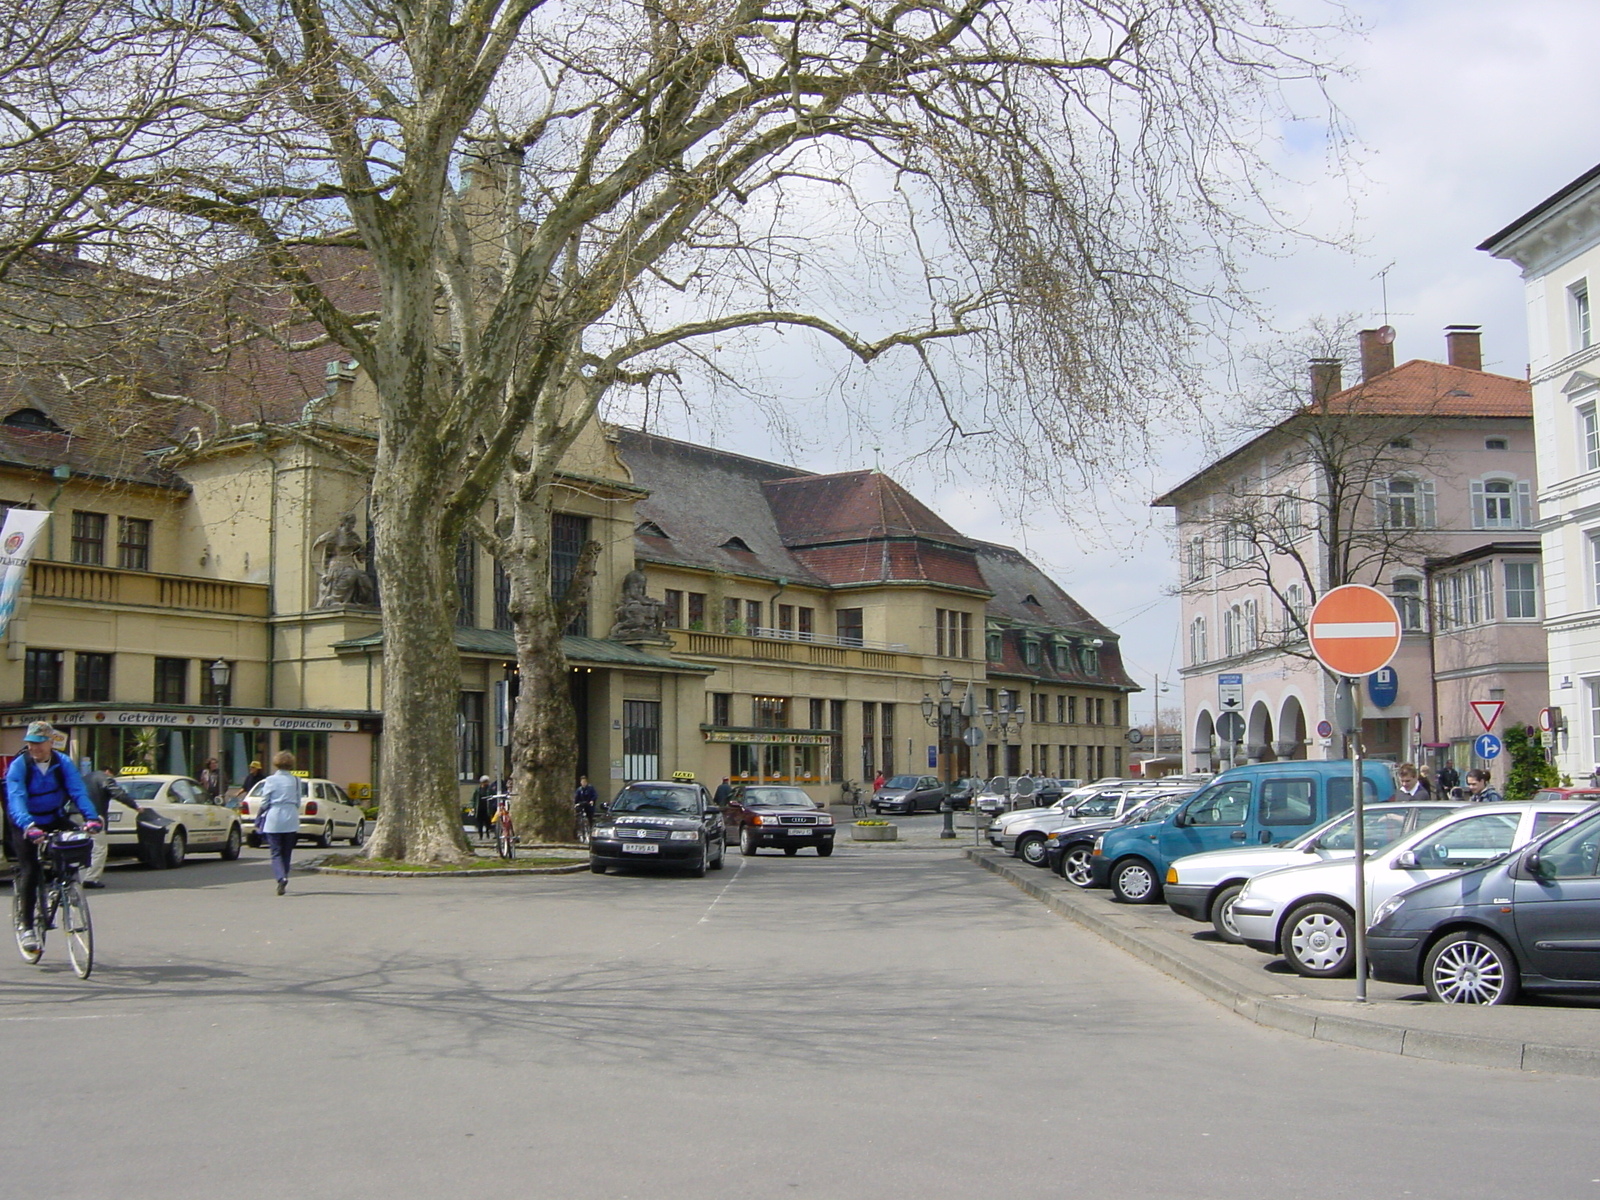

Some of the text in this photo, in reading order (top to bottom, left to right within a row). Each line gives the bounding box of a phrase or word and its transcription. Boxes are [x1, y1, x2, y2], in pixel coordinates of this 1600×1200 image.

[63, 712, 85, 723] Café
[118, 712, 178, 724] Getränke
[272, 718, 333, 729] Cappuccino
